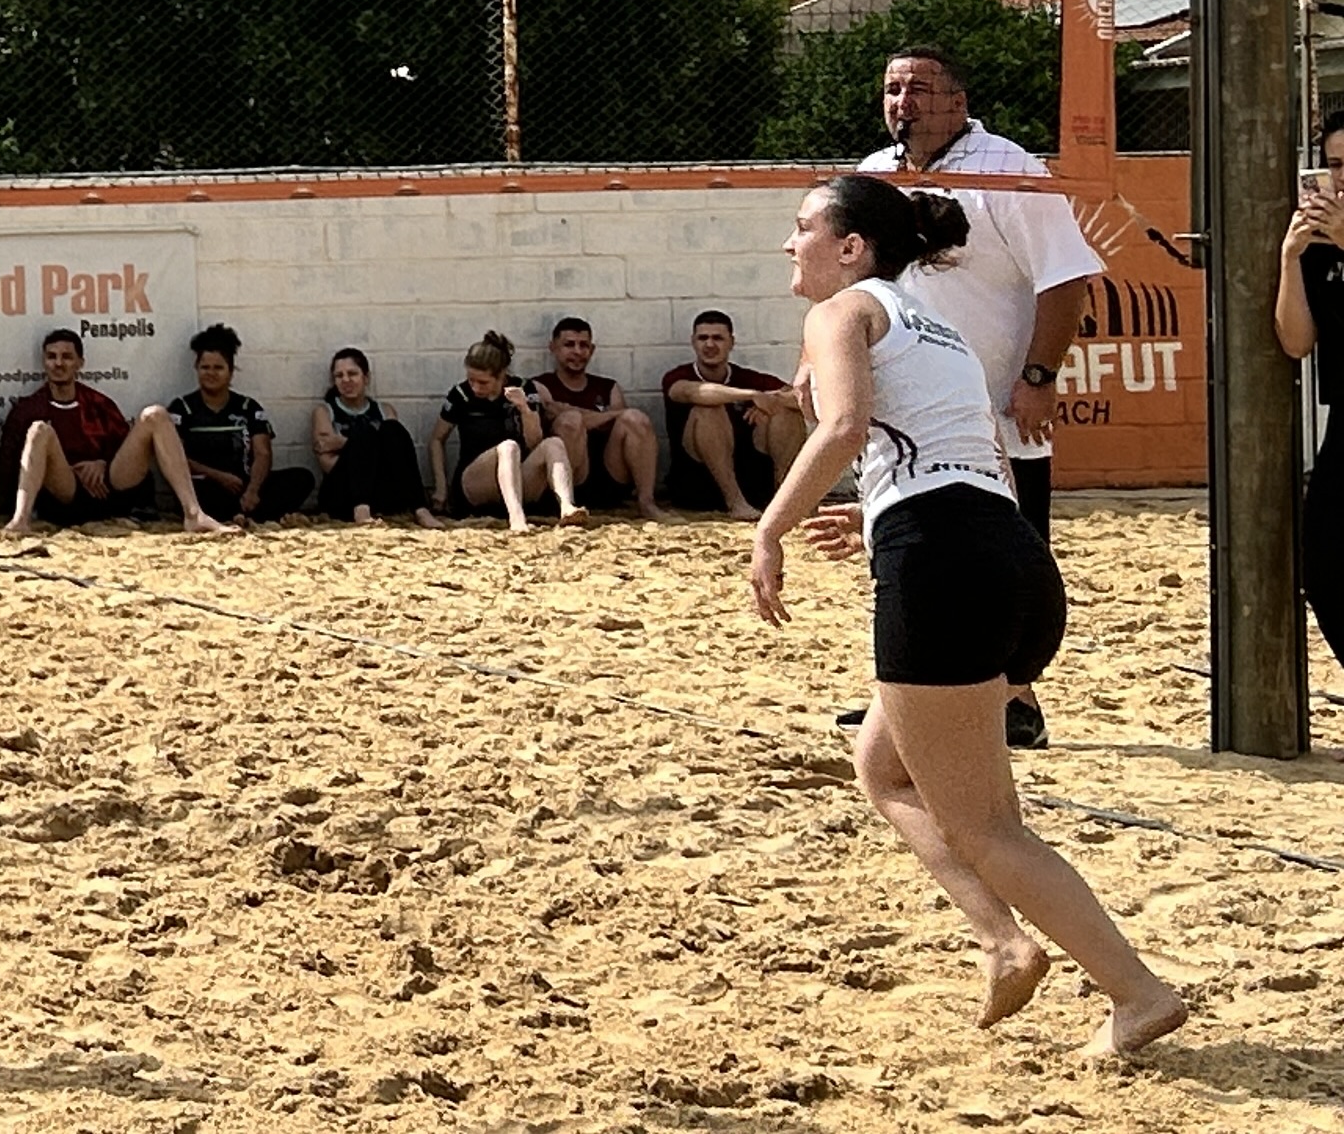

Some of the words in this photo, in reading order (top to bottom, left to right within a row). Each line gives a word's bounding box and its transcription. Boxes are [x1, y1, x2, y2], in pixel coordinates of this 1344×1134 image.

[40, 263, 154, 316] Park
[79, 316, 155, 341] Penápolis
[1055, 341, 1183, 395] AFUT
[1055, 399, 1111, 425] ACH
